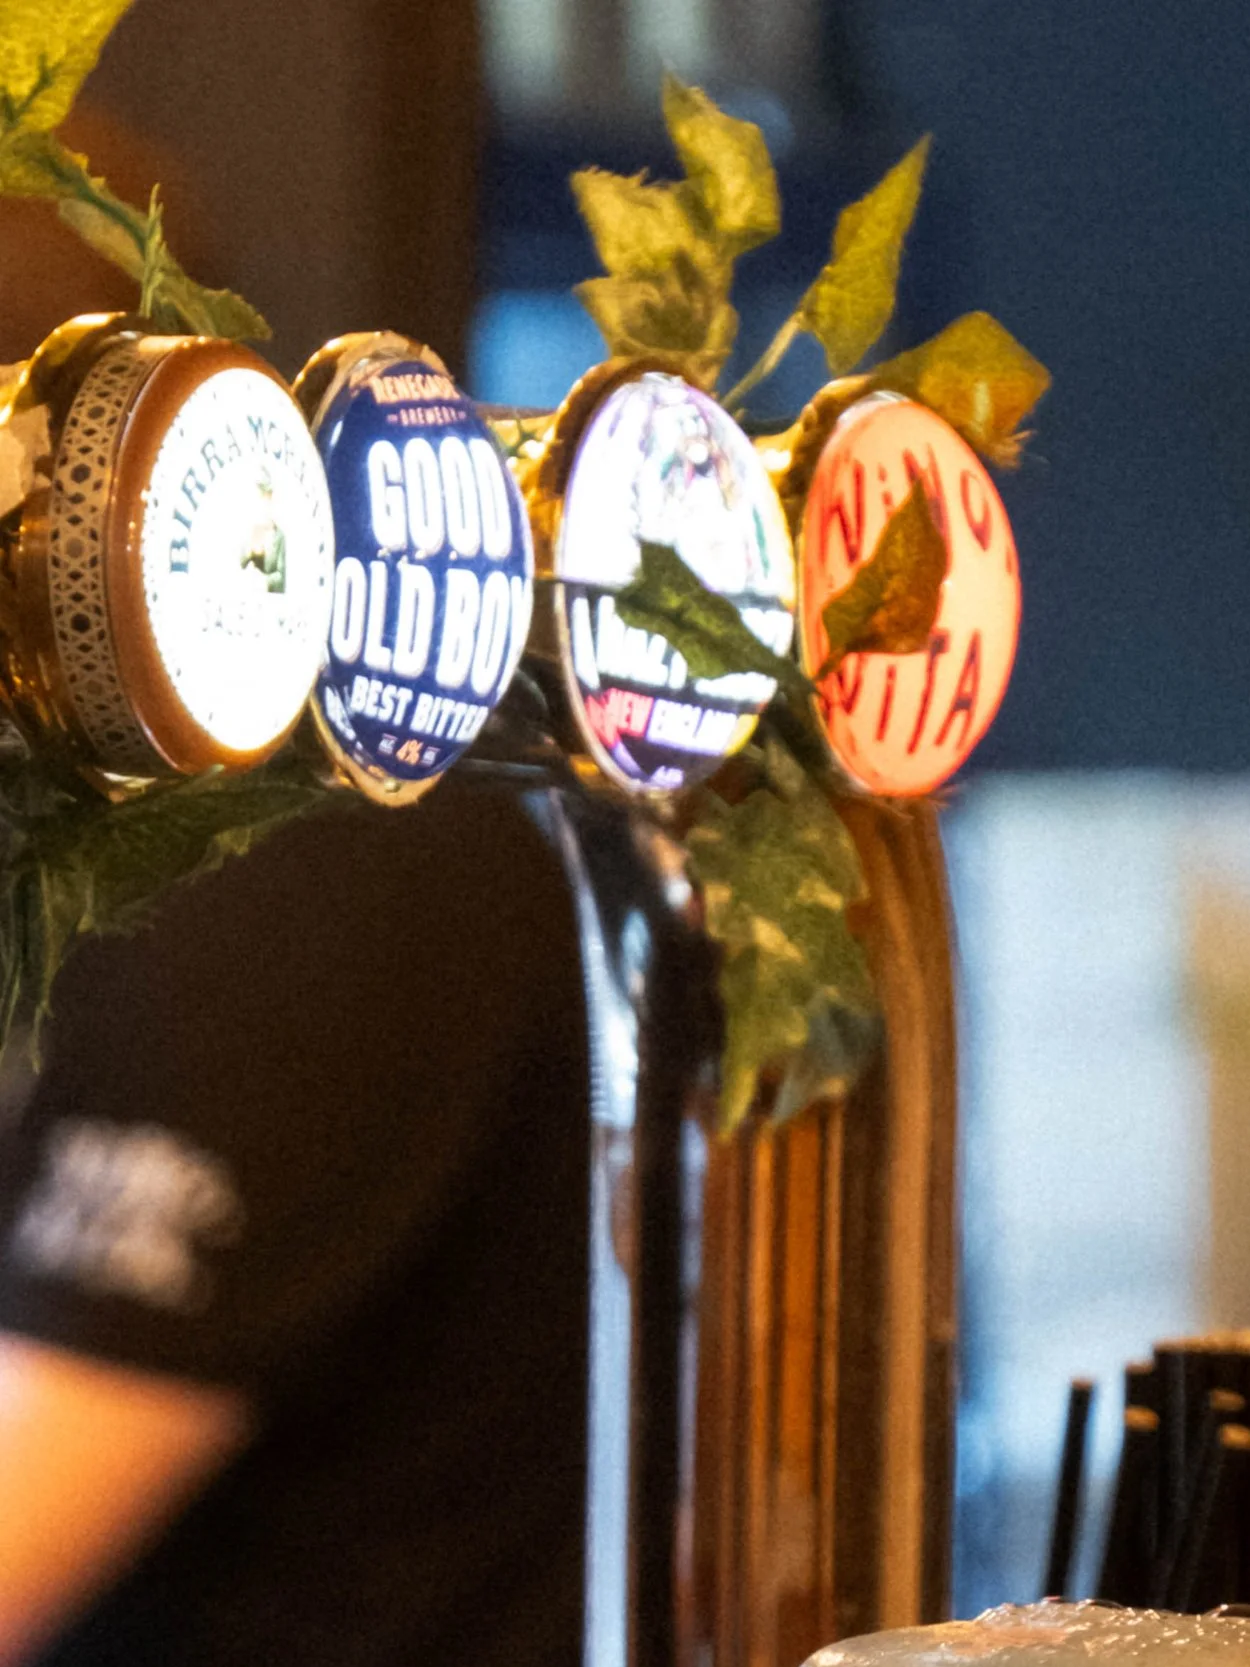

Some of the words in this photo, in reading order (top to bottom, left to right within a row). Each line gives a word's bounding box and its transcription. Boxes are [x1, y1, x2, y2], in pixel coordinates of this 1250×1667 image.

[168, 422, 243, 574] BIRRA
[367, 436, 513, 562] GOOD
[331, 556, 436, 679] OLD
[435, 568, 534, 699] BOY
[350, 675, 414, 727] BEST
